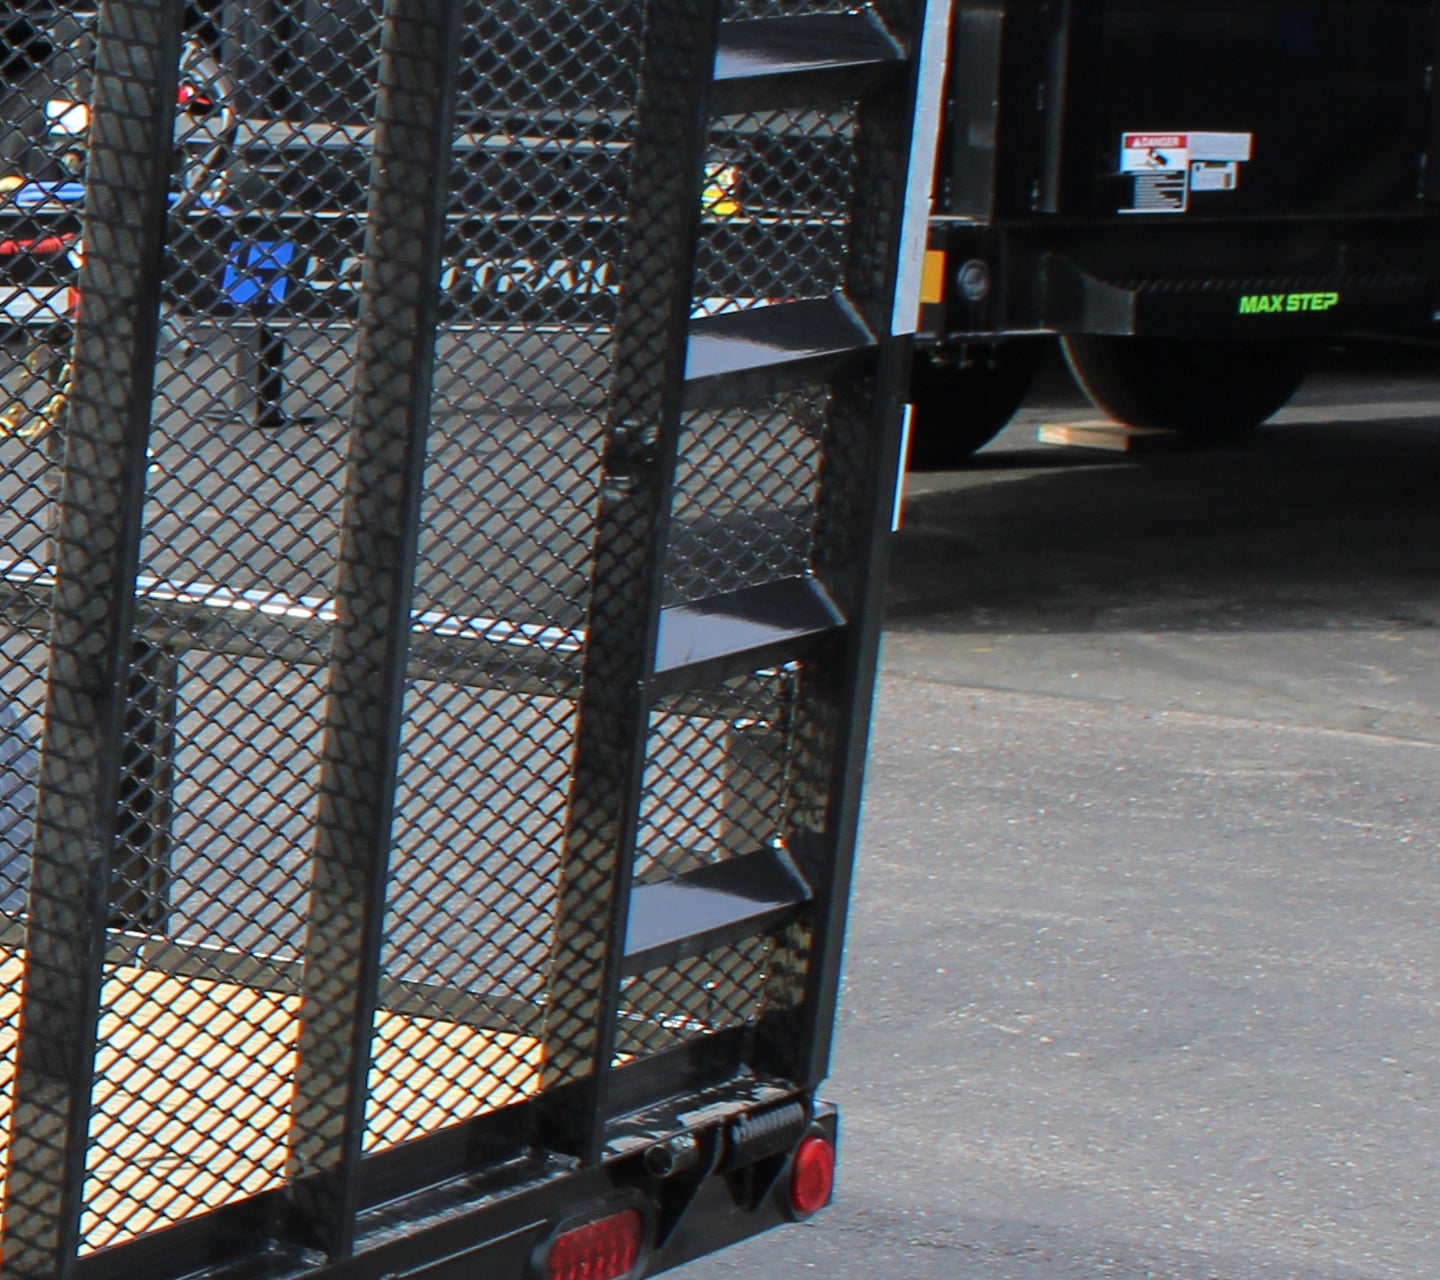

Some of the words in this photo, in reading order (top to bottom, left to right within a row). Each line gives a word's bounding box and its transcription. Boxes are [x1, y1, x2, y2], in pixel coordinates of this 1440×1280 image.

[1142, 136, 1180, 147] DANGER
[1239, 294, 1285, 314] MAX
[1286, 291, 1340, 312] STEP
